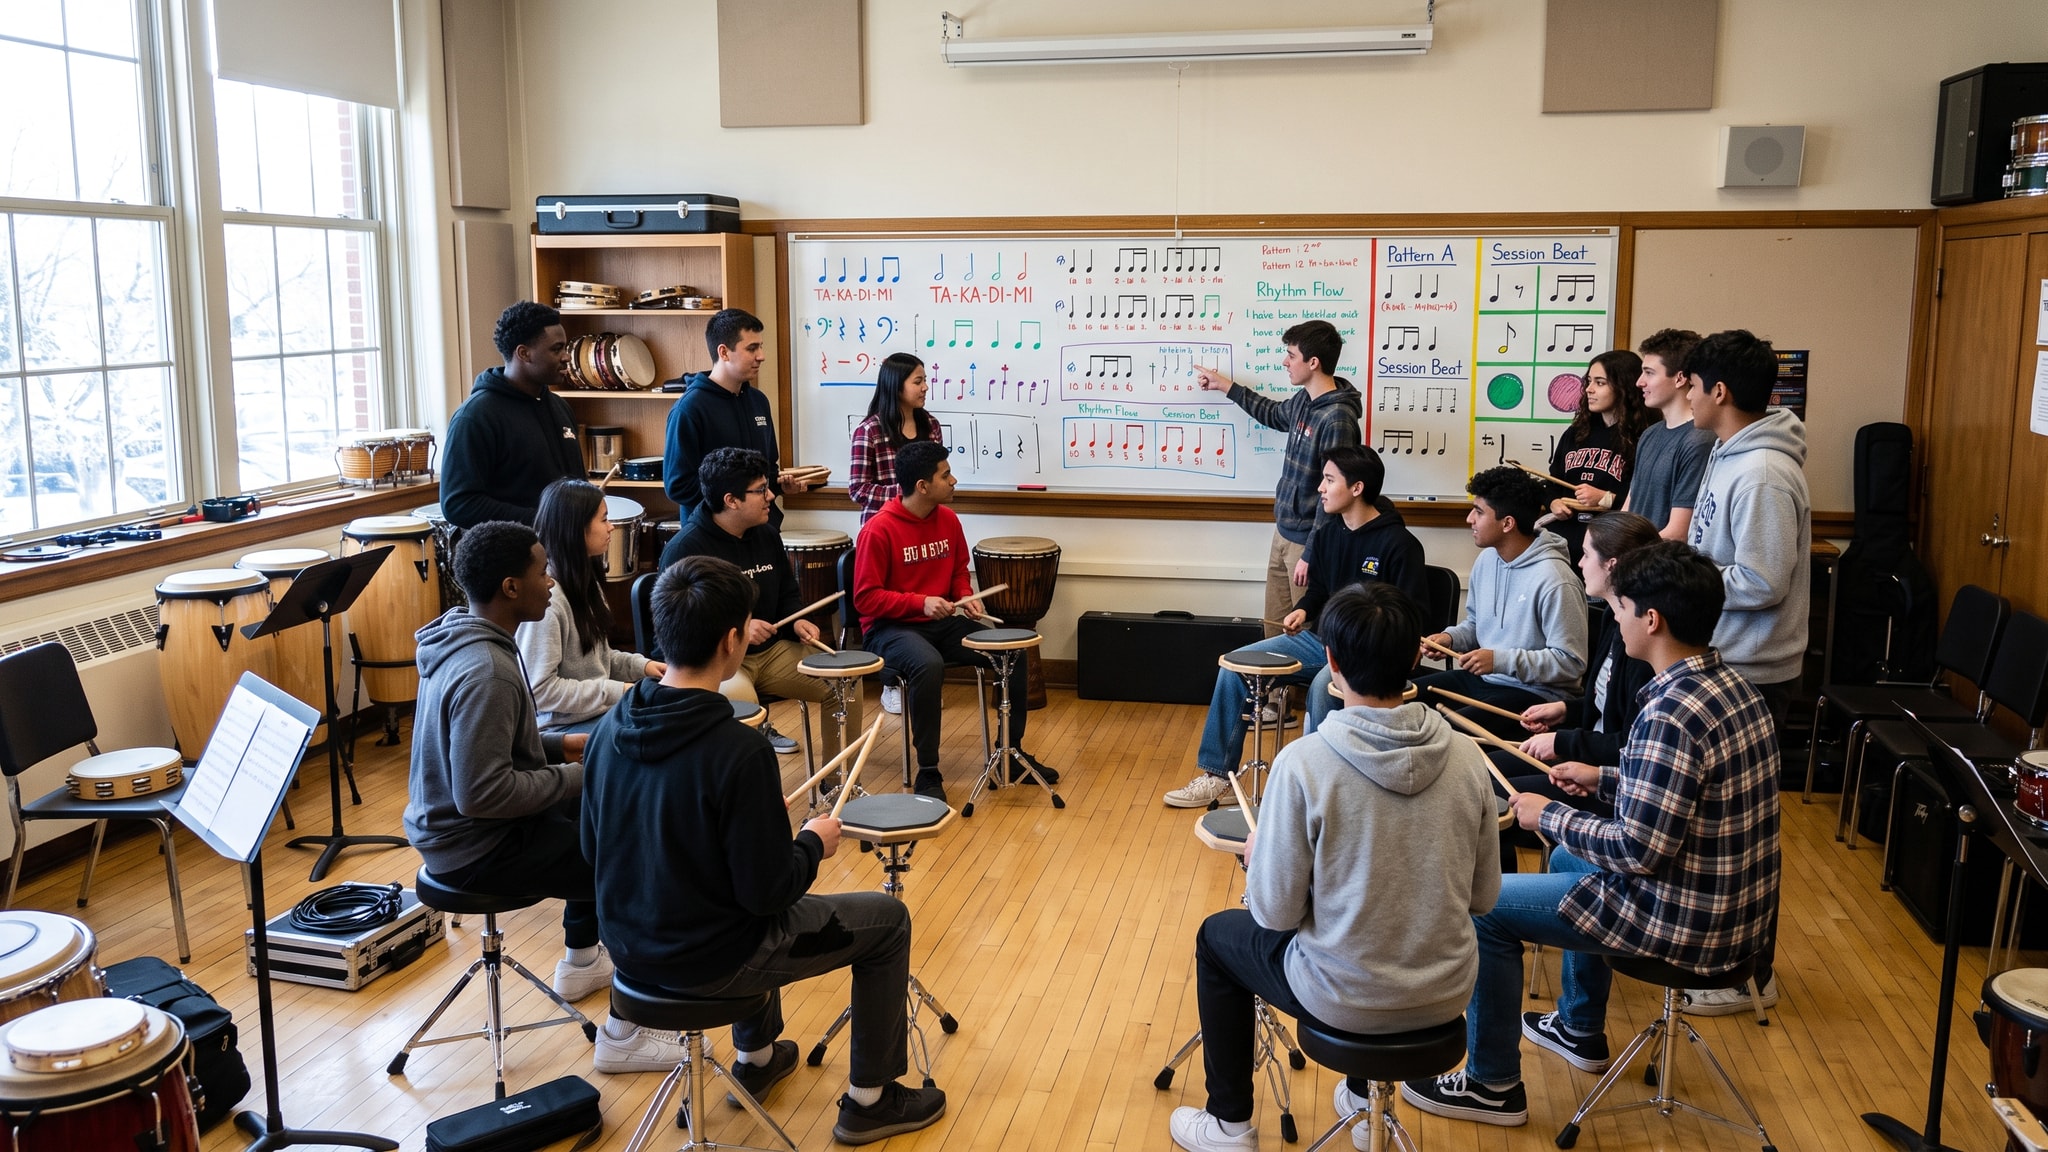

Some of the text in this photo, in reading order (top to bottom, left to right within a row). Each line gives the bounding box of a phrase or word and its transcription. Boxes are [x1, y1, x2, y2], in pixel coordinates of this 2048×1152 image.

[1262, 244, 1291, 255] Pattern
[1388, 244, 1455, 263] Pattern A
[1492, 243, 1589, 261] Session Beat
[1262, 261, 1291, 271] Pattern
[814, 288, 893, 302] TA-KA-DI-MI
[930, 286, 1033, 304] TA-KA-DI-MI
[1257, 281, 1344, 301] Rhythm Flow
[1252, 309, 1274, 319] have
[1378, 357, 1427, 375] Session
[1431, 358, 1464, 376] Beat
[1078, 403, 1112, 417] Rhythm
